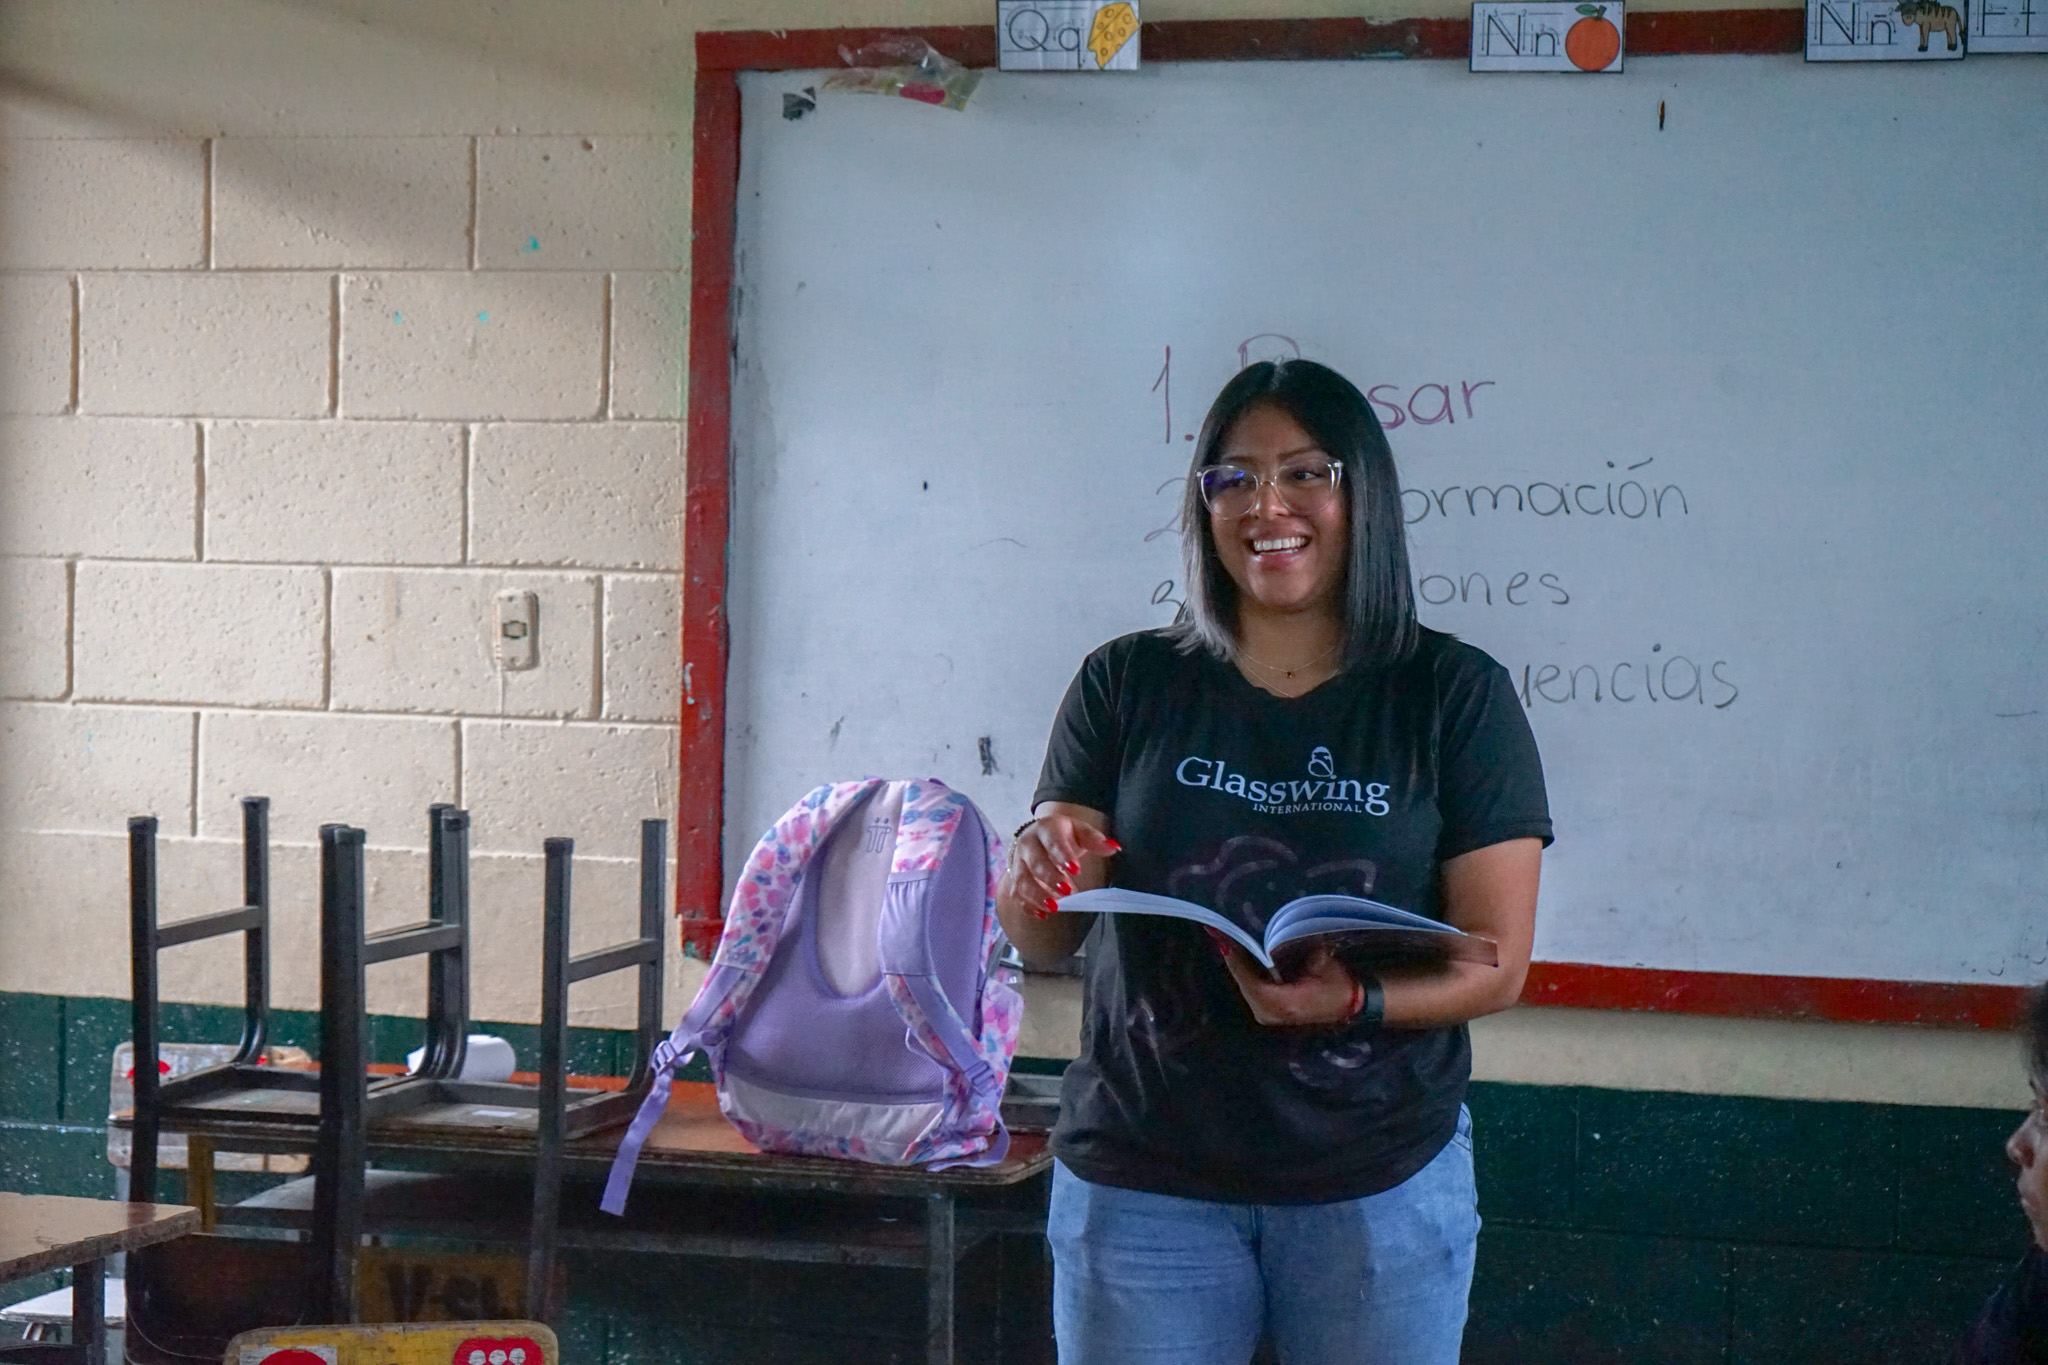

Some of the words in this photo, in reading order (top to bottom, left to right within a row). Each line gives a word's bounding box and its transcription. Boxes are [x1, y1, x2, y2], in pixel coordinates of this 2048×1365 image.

[1008, 9, 1081, 68] Qq
[1486, 14, 1556, 57] Nn
[1152, 345, 1195, 444] 1.
[1400, 456, 1689, 526] ormación
[1418, 571, 1571, 607] ones
[1176, 756, 1390, 816] Glasswing
[1252, 802, 1363, 816] INTERNATIONAL
